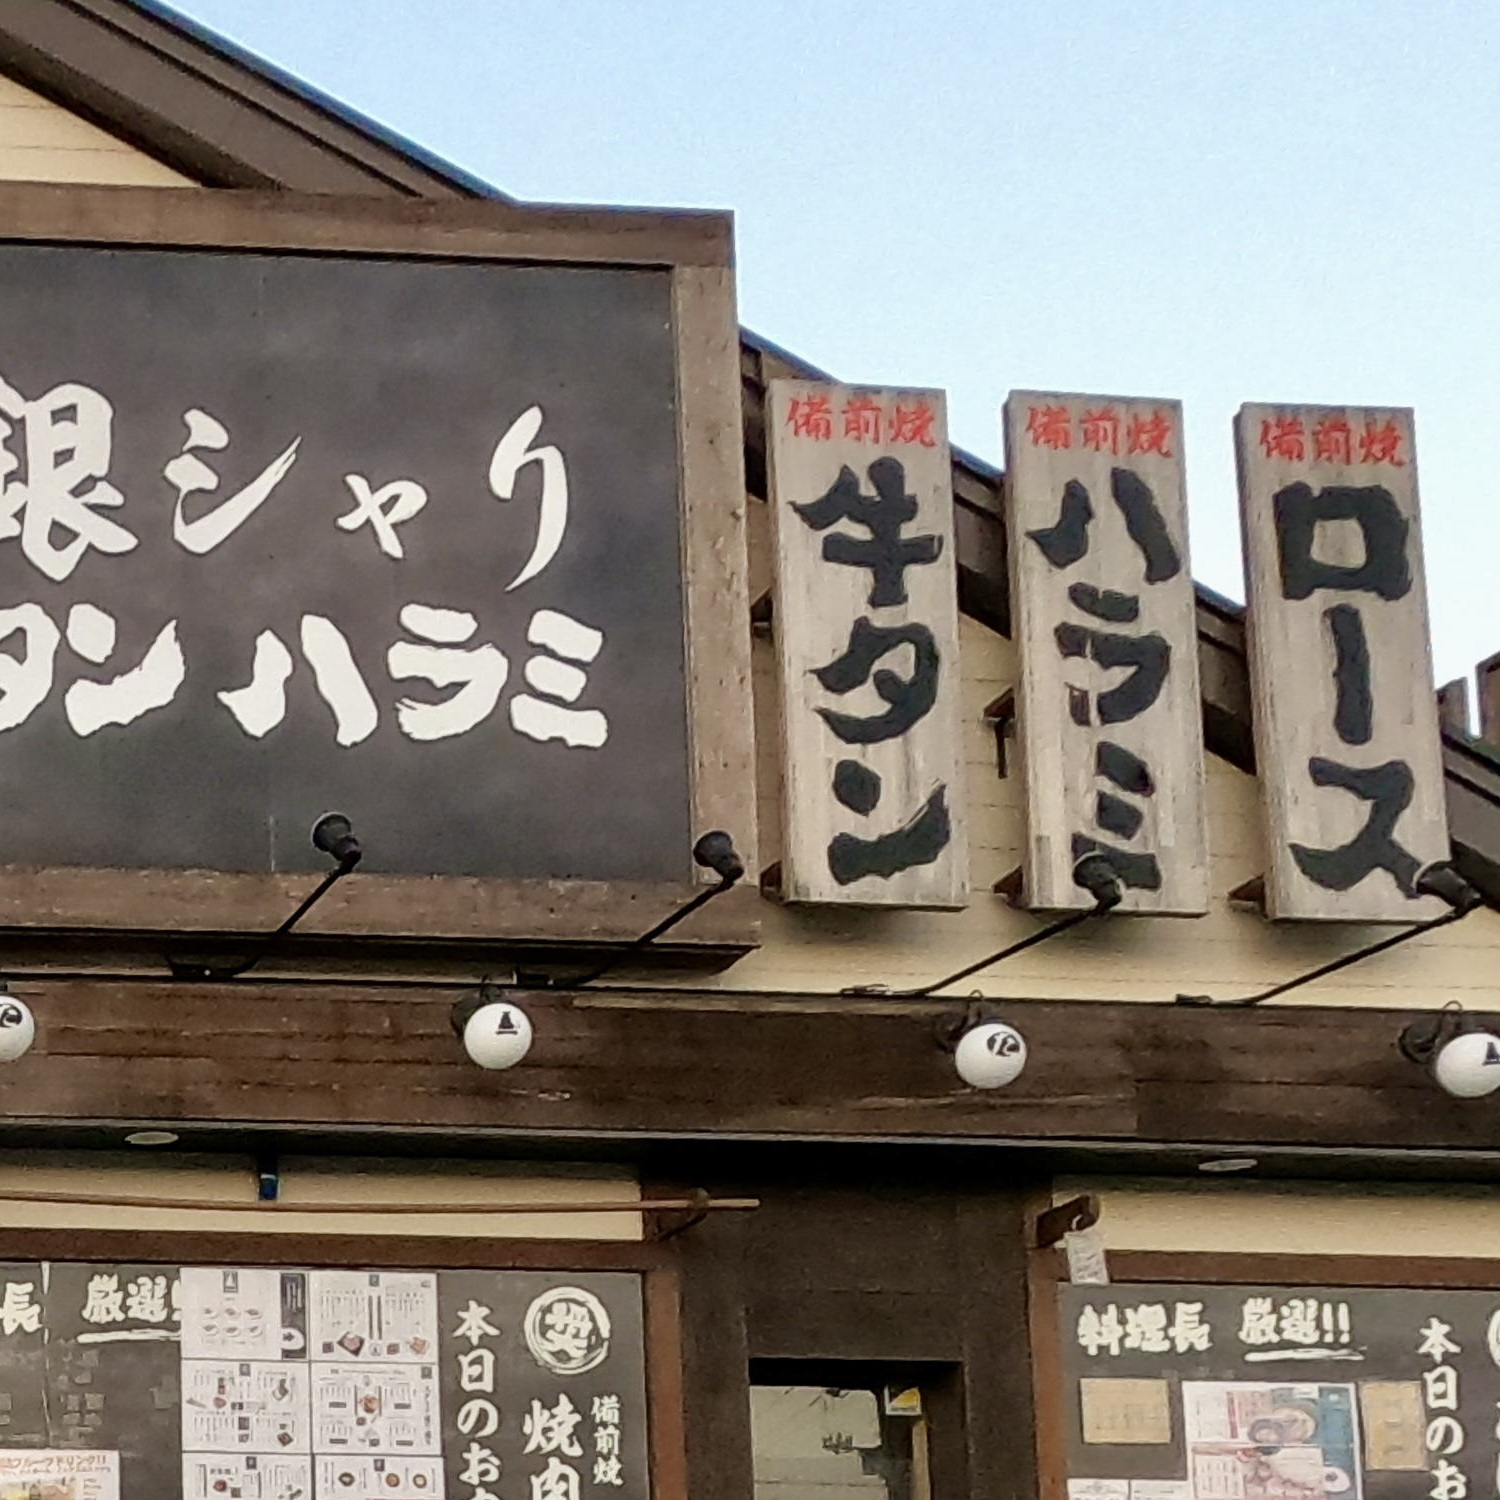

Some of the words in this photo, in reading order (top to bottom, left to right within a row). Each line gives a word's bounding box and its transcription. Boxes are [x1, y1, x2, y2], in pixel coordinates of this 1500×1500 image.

[785, 396, 937, 449] 備前焼
[1026, 405, 1173, 459] 備前焼
[1259, 418, 1408, 468] 備前焼
[788, 456, 951, 887] 牛タン
[1025, 467, 1181, 892] ハラミ
[1273, 480, 1422, 899] ロース
[1077, 1301, 1213, 1356] 料理長
[591, 1394, 624, 1486] 備前焼
